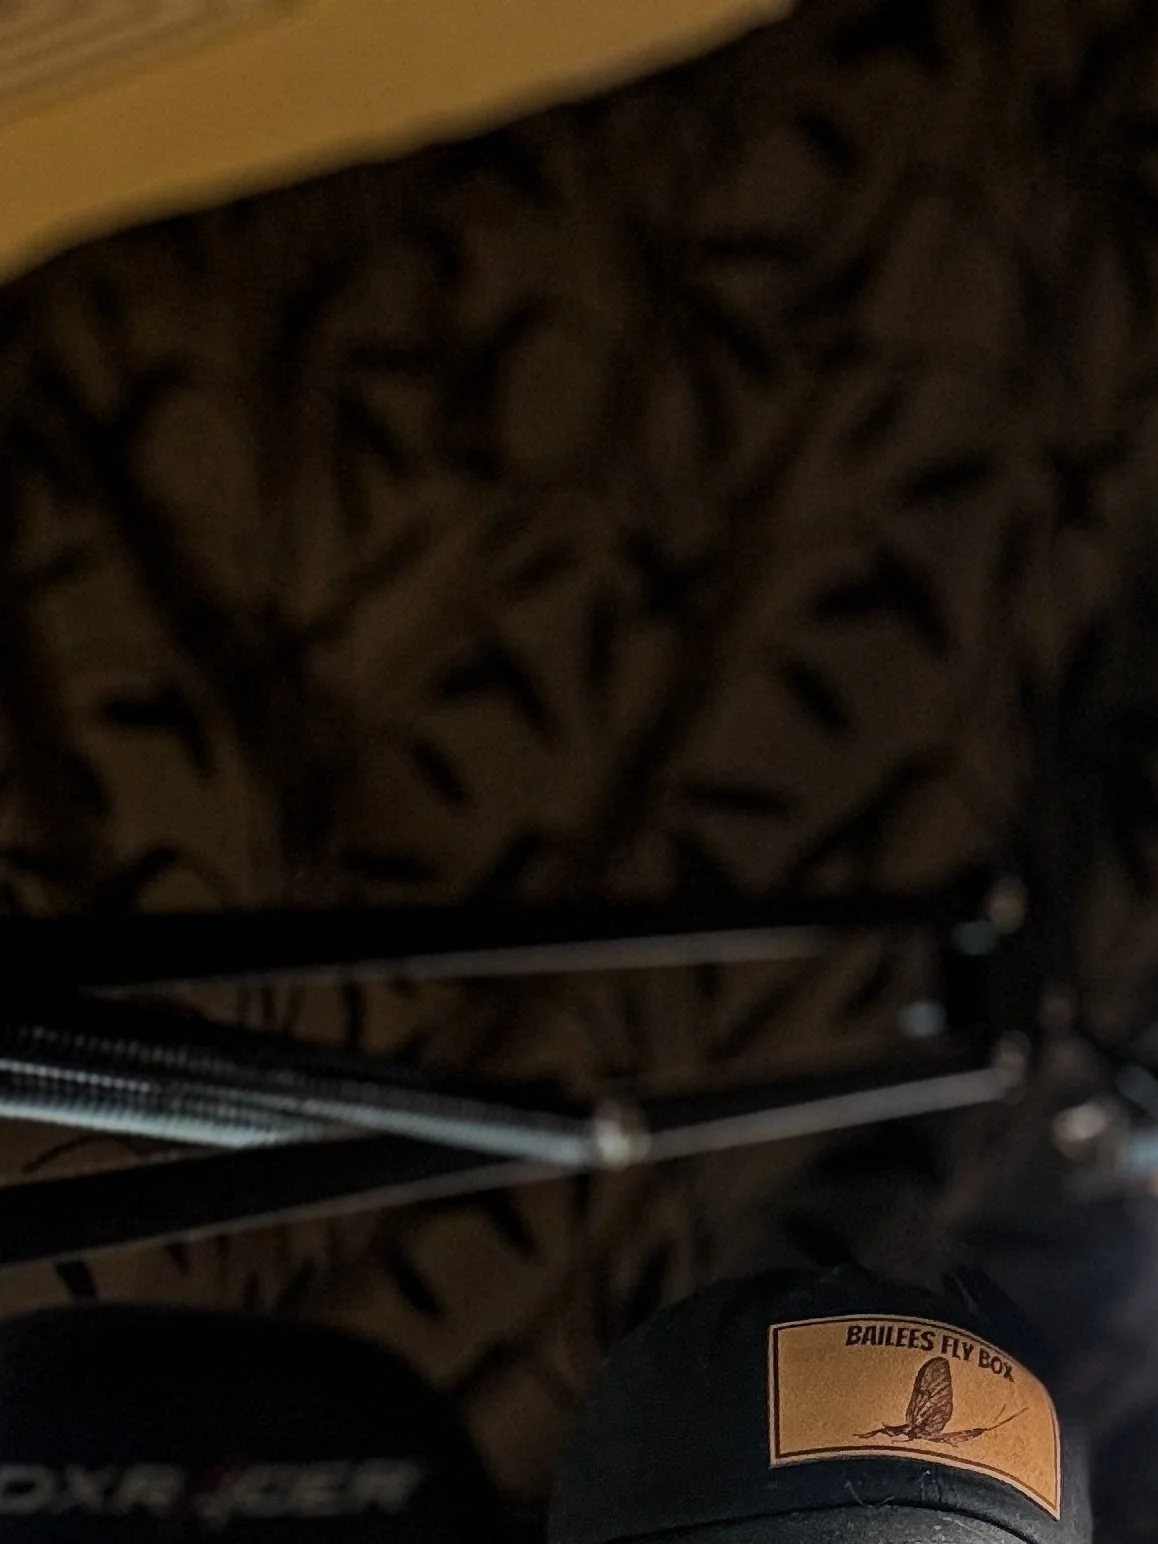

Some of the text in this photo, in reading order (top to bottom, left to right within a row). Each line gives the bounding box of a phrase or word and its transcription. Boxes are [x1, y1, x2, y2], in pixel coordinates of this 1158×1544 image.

[845, 1325, 1015, 1382] BAILEES FLY BOX
